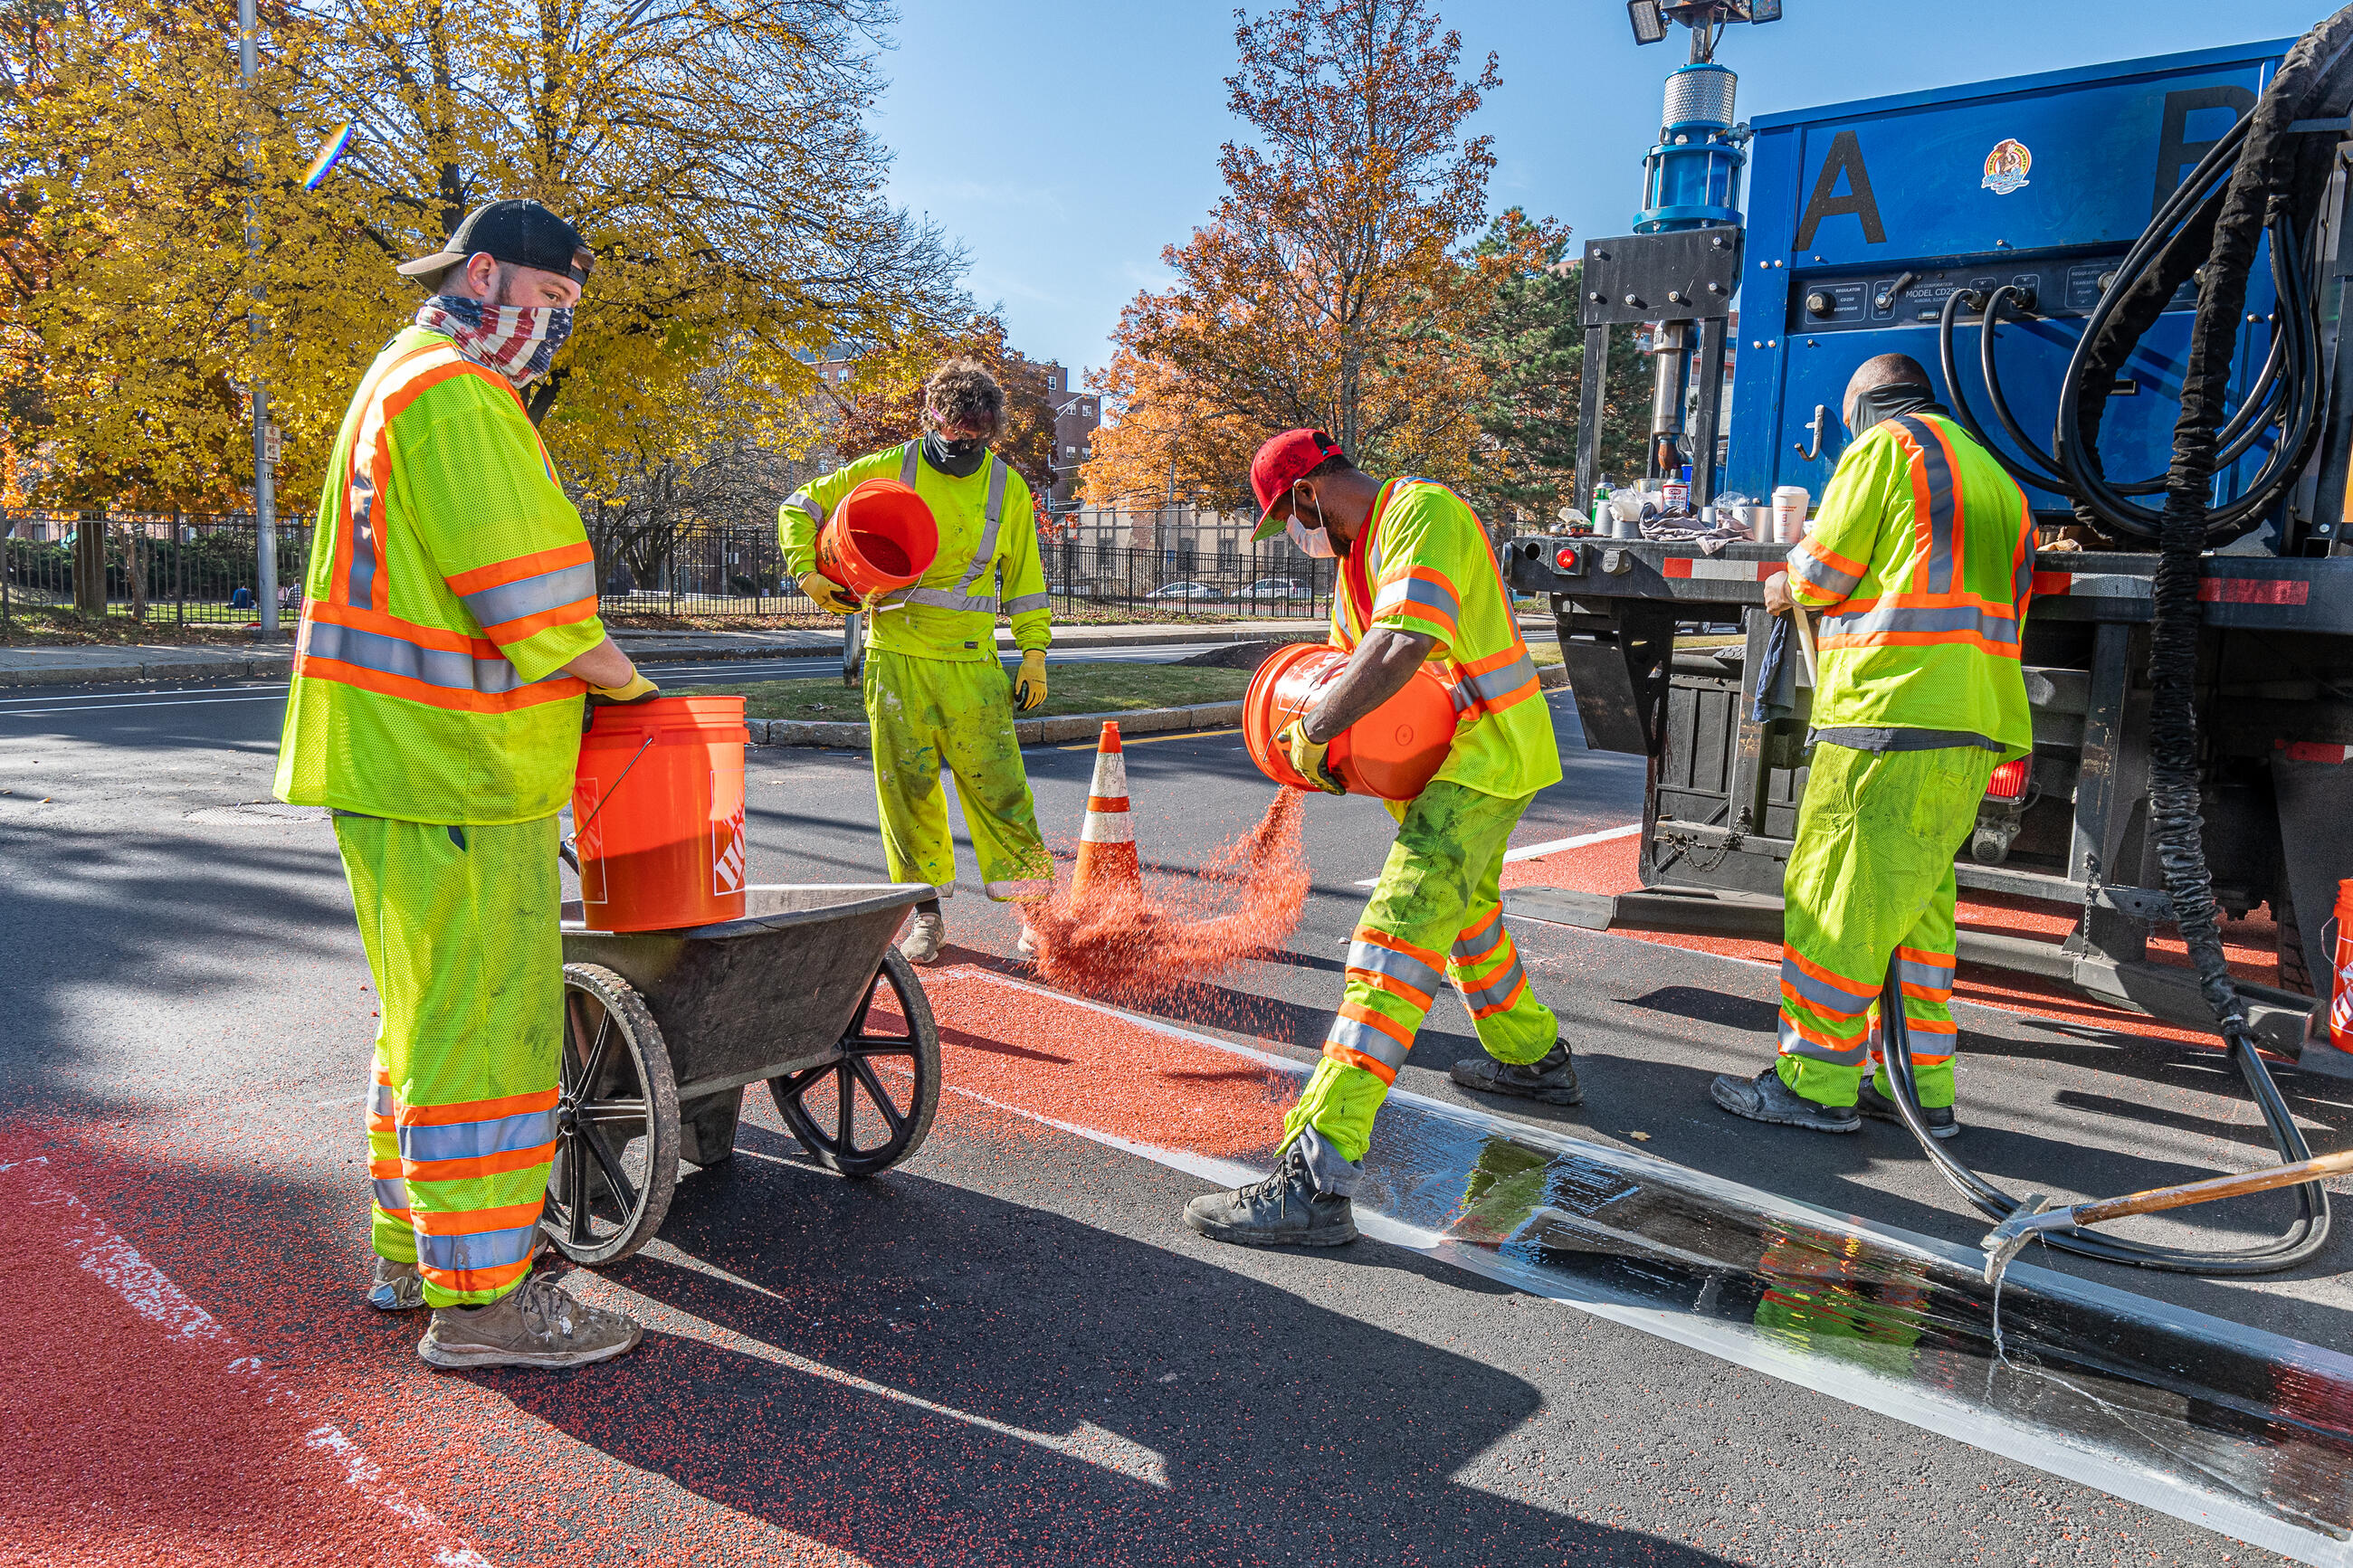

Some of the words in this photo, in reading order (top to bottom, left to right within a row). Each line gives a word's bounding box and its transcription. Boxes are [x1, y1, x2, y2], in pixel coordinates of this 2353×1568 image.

[1792, 130, 1887, 252] A
[1905, 289, 1932, 298] MODEL
[269, 427, 276, 436] NO
[714, 820, 746, 892] HO
